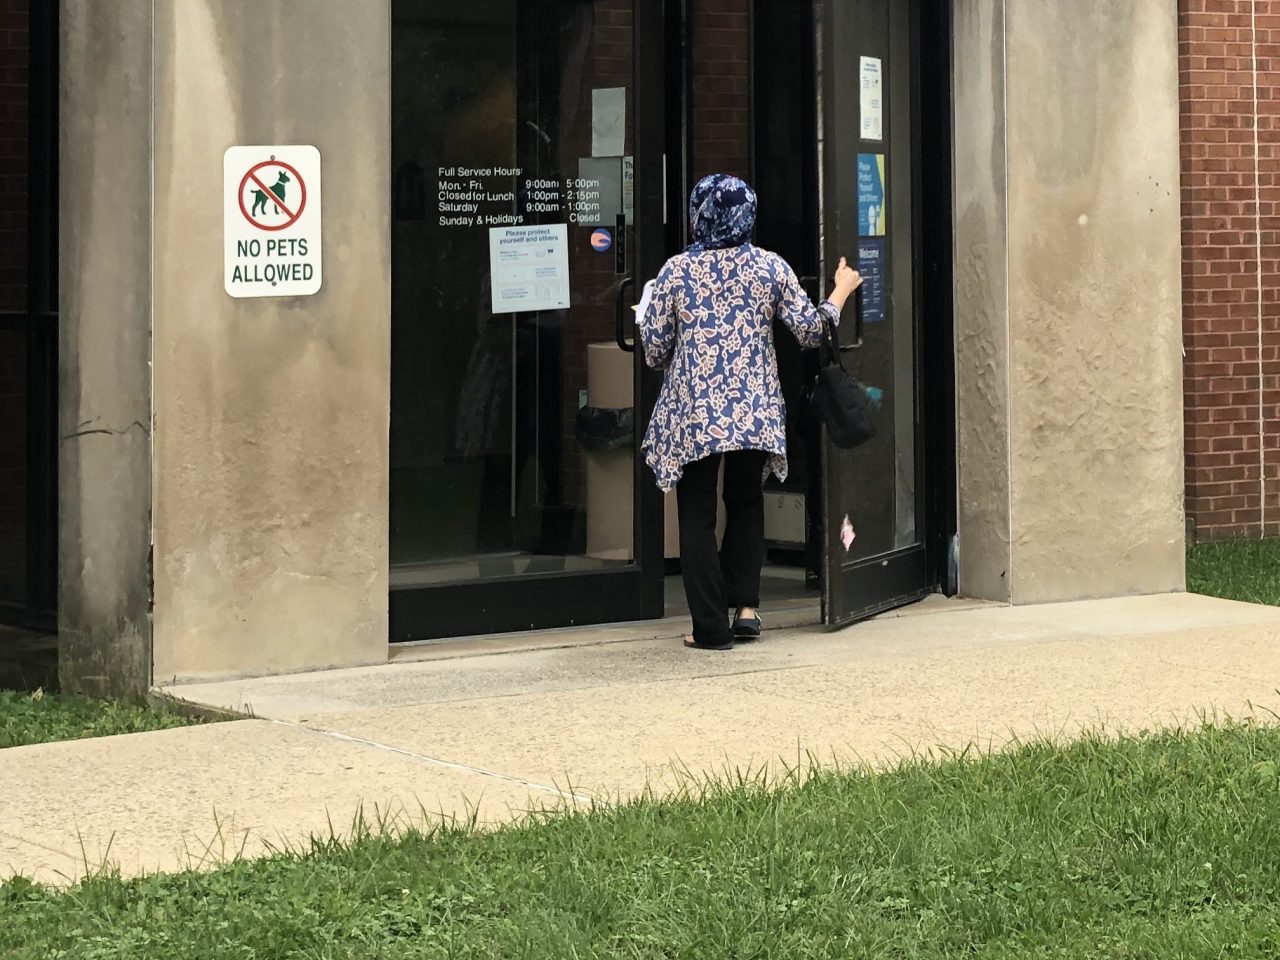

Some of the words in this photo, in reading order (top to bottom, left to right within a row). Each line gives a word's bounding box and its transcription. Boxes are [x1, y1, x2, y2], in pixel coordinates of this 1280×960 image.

[438, 167, 455, 177] Full
[457, 167, 492, 177] Service
[438, 180, 462, 191] Mon.
[469, 180, 484, 190] Fri.
[438, 191, 472, 201] Closed
[472, 191, 486, 201] for
[487, 191, 515, 202] Lunch
[526, 191, 559, 202] 1:00pm
[566, 190, 600, 201] 2:15pm
[438, 201, 479, 214] Saturday
[525, 202, 560, 213] 9:00am
[567, 201, 600, 213] 1:00pm
[438, 215, 474, 228] Sunday
[476, 215, 484, 225] &
[485, 213, 524, 226] Holidays
[569, 212, 600, 223] Closed
[527, 229, 551, 237] protect
[499, 237, 525, 245] yourself
[237, 239, 261, 258] NO
[266, 238, 309, 257] PETS
[231, 263, 314, 283] ALLOWED
